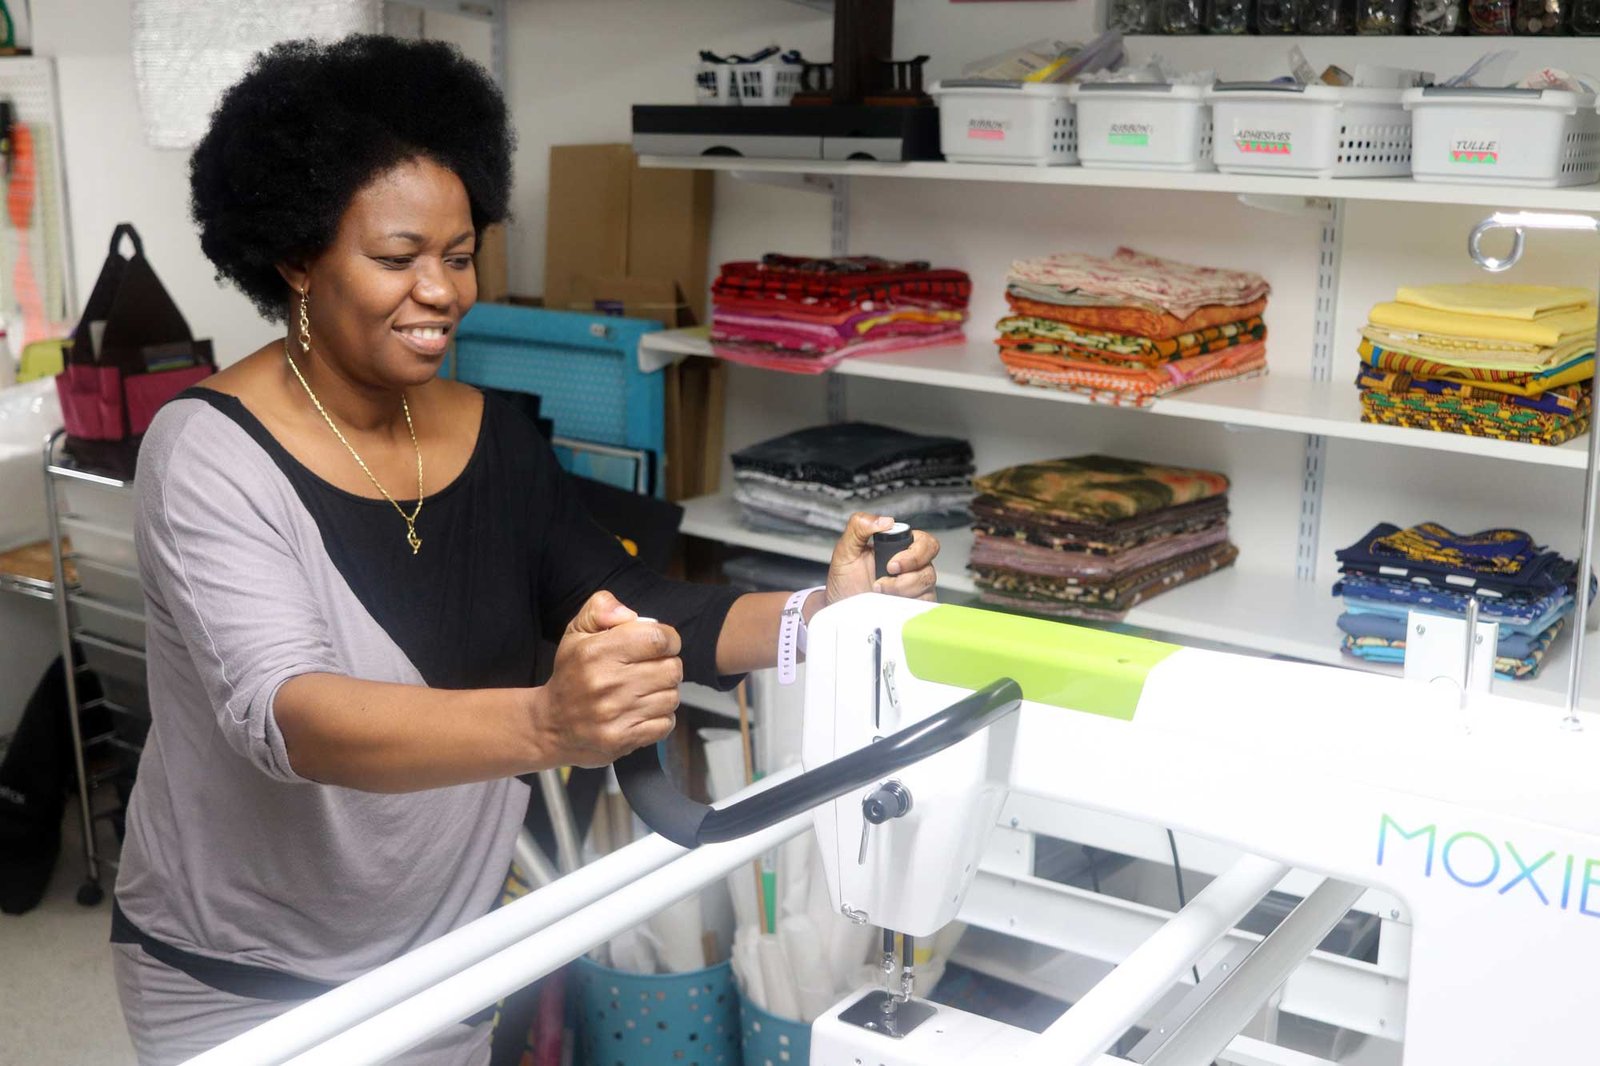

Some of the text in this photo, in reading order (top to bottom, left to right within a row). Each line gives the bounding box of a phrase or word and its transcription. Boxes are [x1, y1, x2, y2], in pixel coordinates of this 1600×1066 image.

[1236, 129, 1291, 141] ADHESIVES
[1456, 140, 1497, 151] TULLE
[1377, 813, 1600, 919] MOXIE
